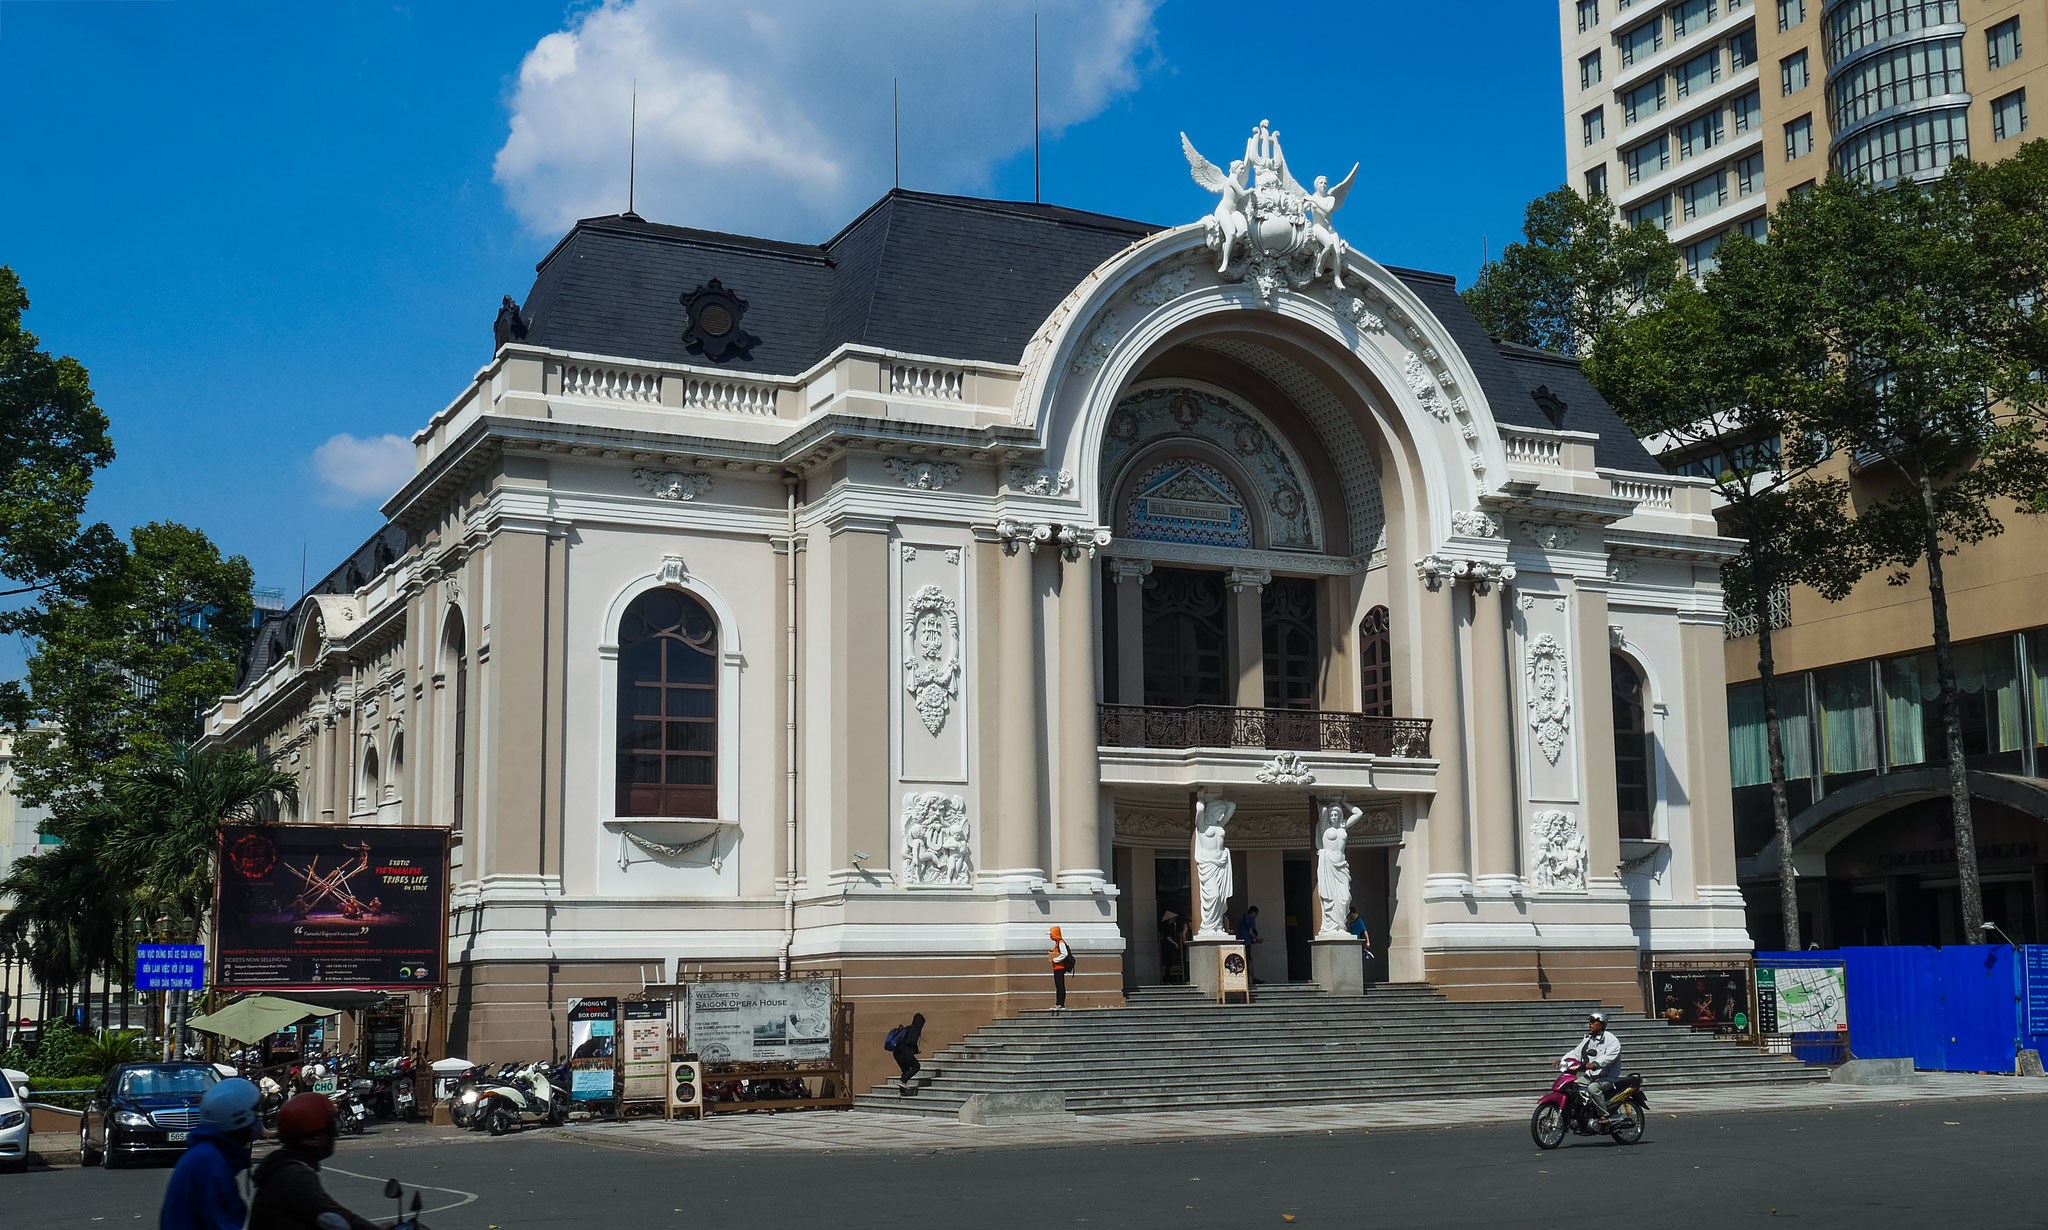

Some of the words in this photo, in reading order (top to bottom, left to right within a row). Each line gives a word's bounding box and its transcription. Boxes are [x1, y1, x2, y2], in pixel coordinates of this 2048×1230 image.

[382, 875, 409, 884] TRIBES
[411, 875, 430, 884] LIFE
[695, 1000, 727, 1009] SAIGON
[760, 999, 788, 1007] HOUSE
